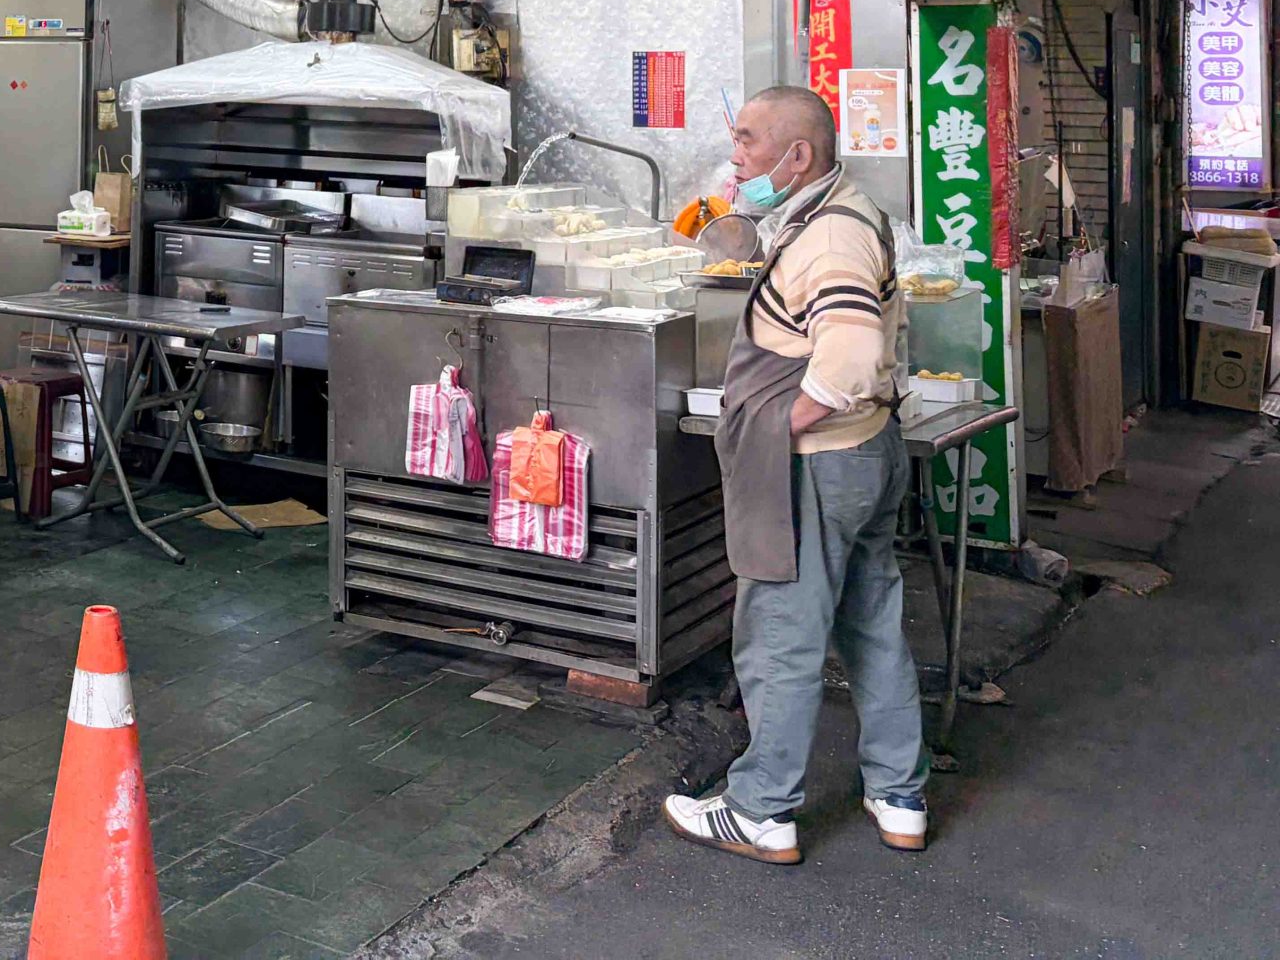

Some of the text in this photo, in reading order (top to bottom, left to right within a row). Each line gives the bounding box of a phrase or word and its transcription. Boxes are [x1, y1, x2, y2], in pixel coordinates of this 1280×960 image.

[1202, 35, 1239, 51] 美甲
[1203, 61, 1240, 76] 美容
[927, 25, 1000, 516] 名豐豆品
